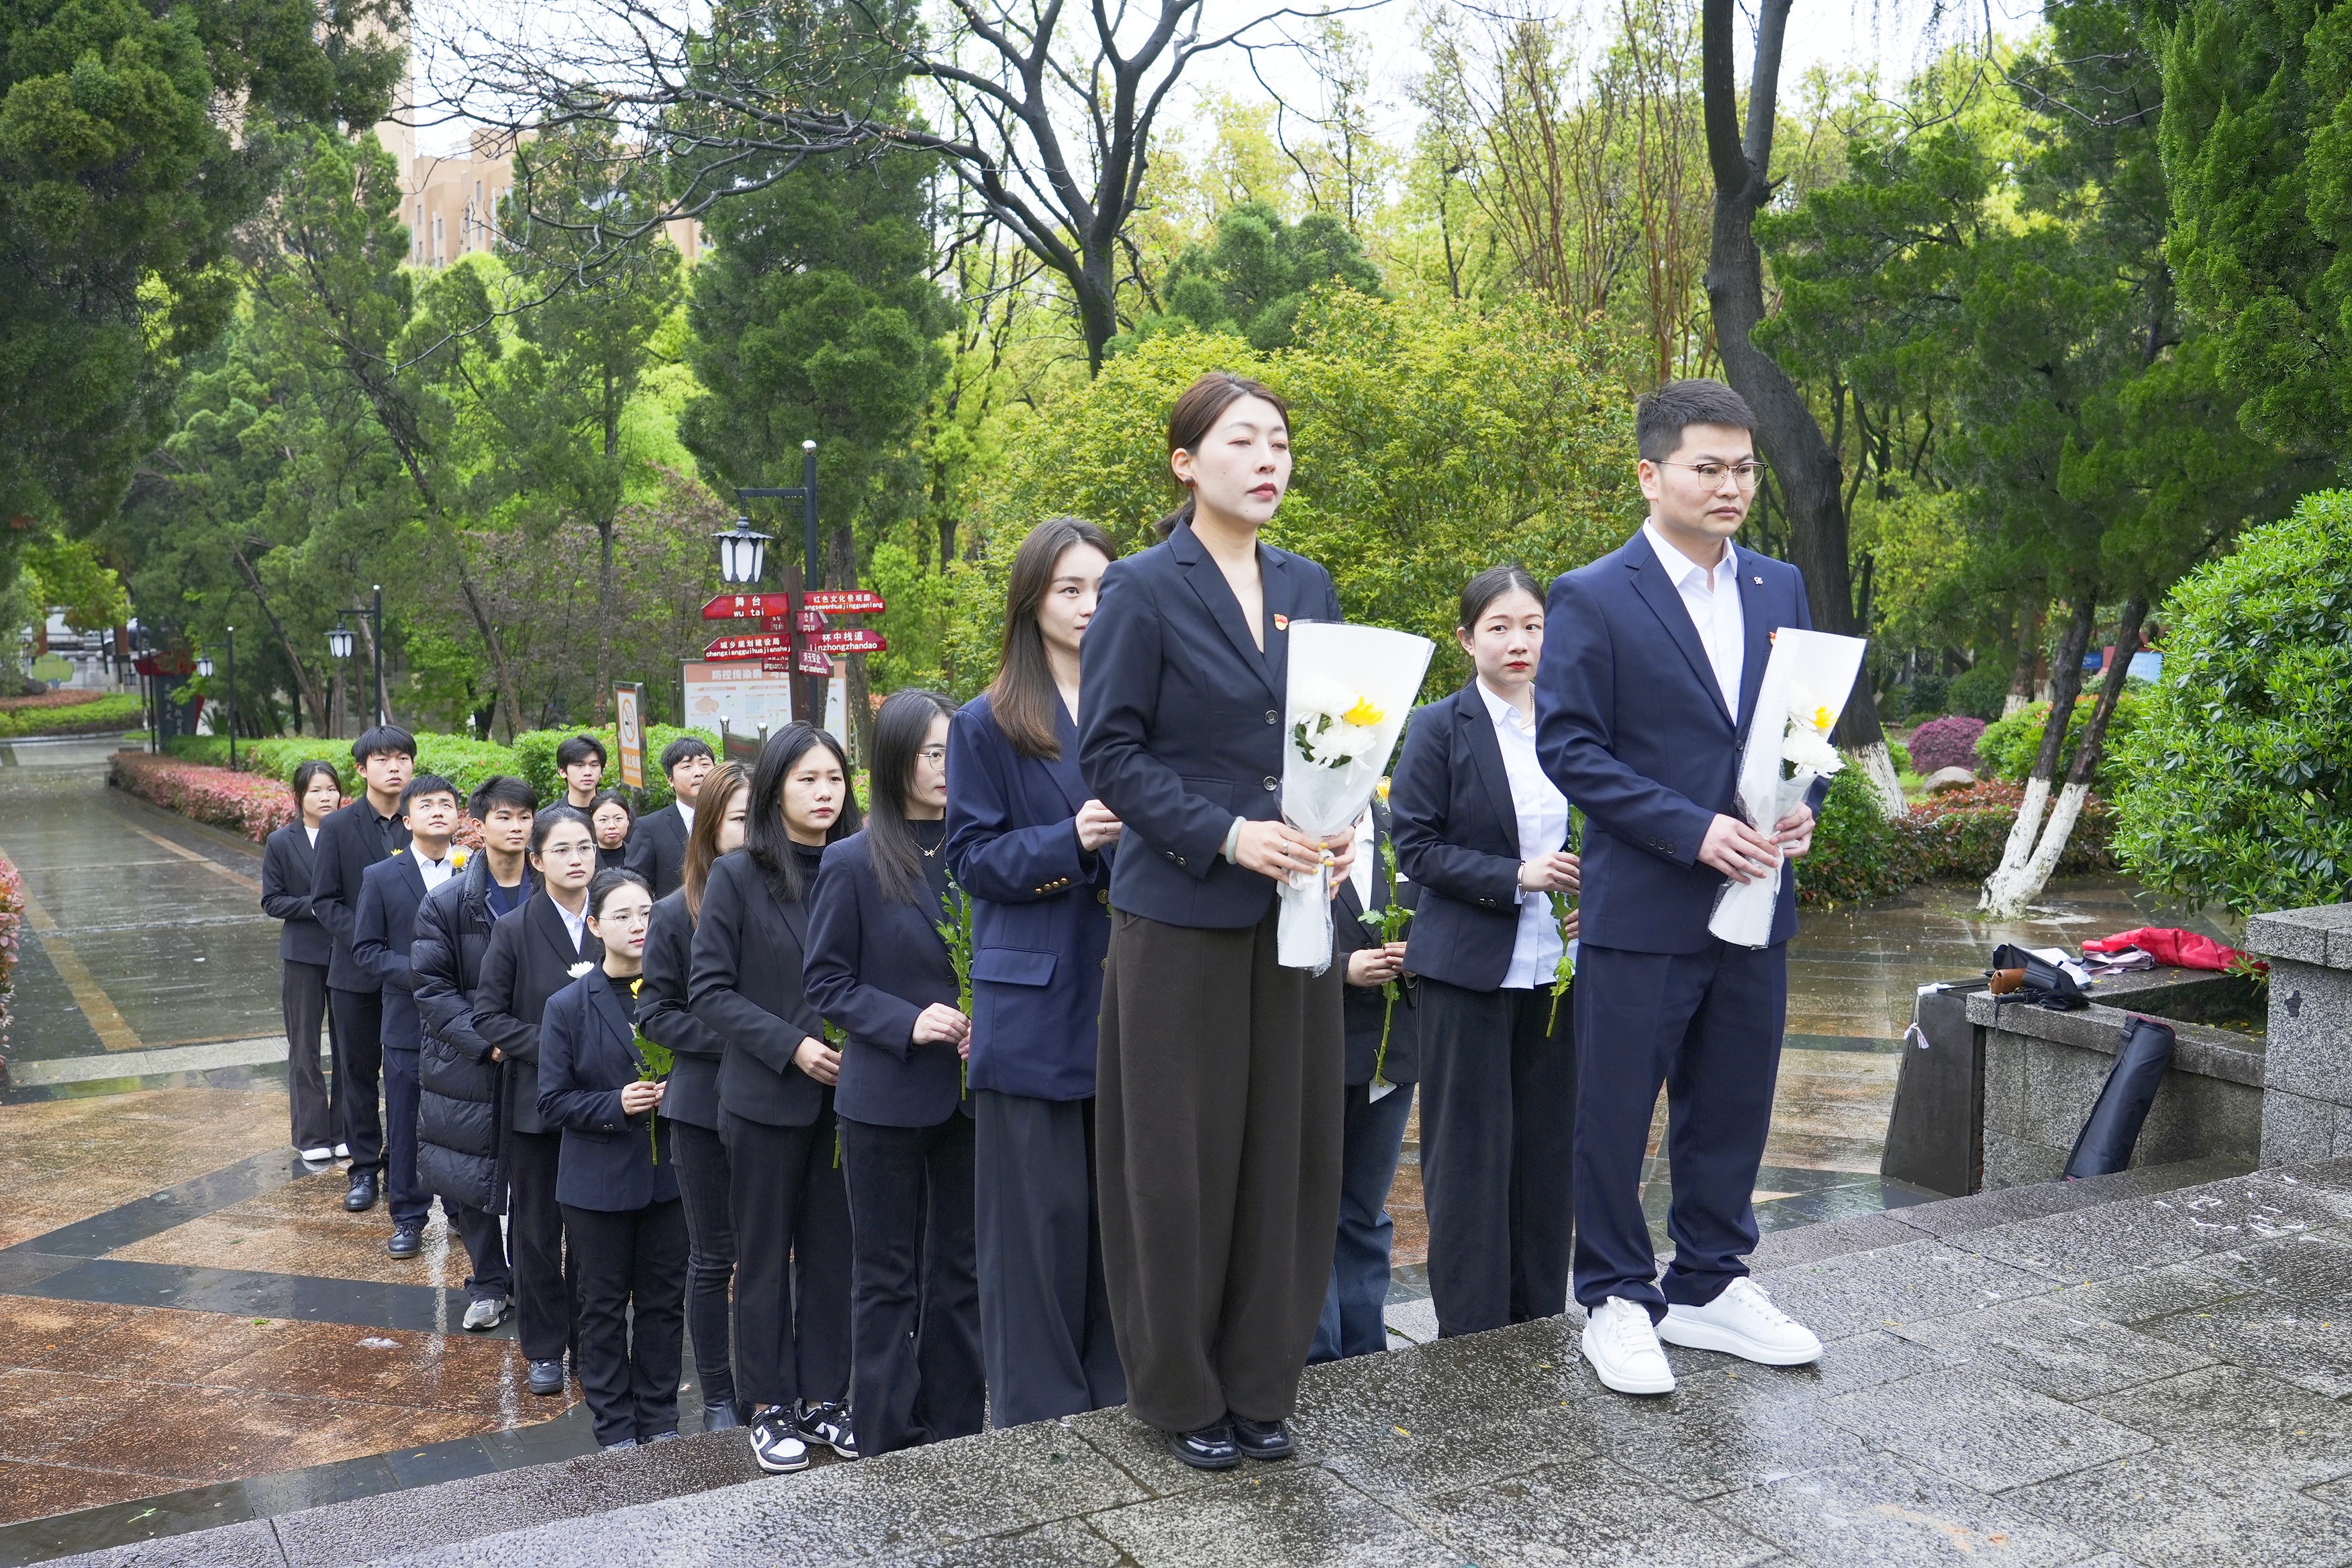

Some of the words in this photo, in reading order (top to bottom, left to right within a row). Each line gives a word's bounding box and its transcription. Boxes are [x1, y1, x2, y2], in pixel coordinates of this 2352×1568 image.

[734, 596, 761, 607] 舞台
[813, 594, 871, 603] 红色文化景观廊
[750, 607, 765, 616] tai
[822, 631, 863, 642] 林中栈道
[720, 638, 780, 649] 城乡规划建设局
[810, 641, 878, 652] linzhongzhandao
[712, 669, 763, 681] 防控传染病
